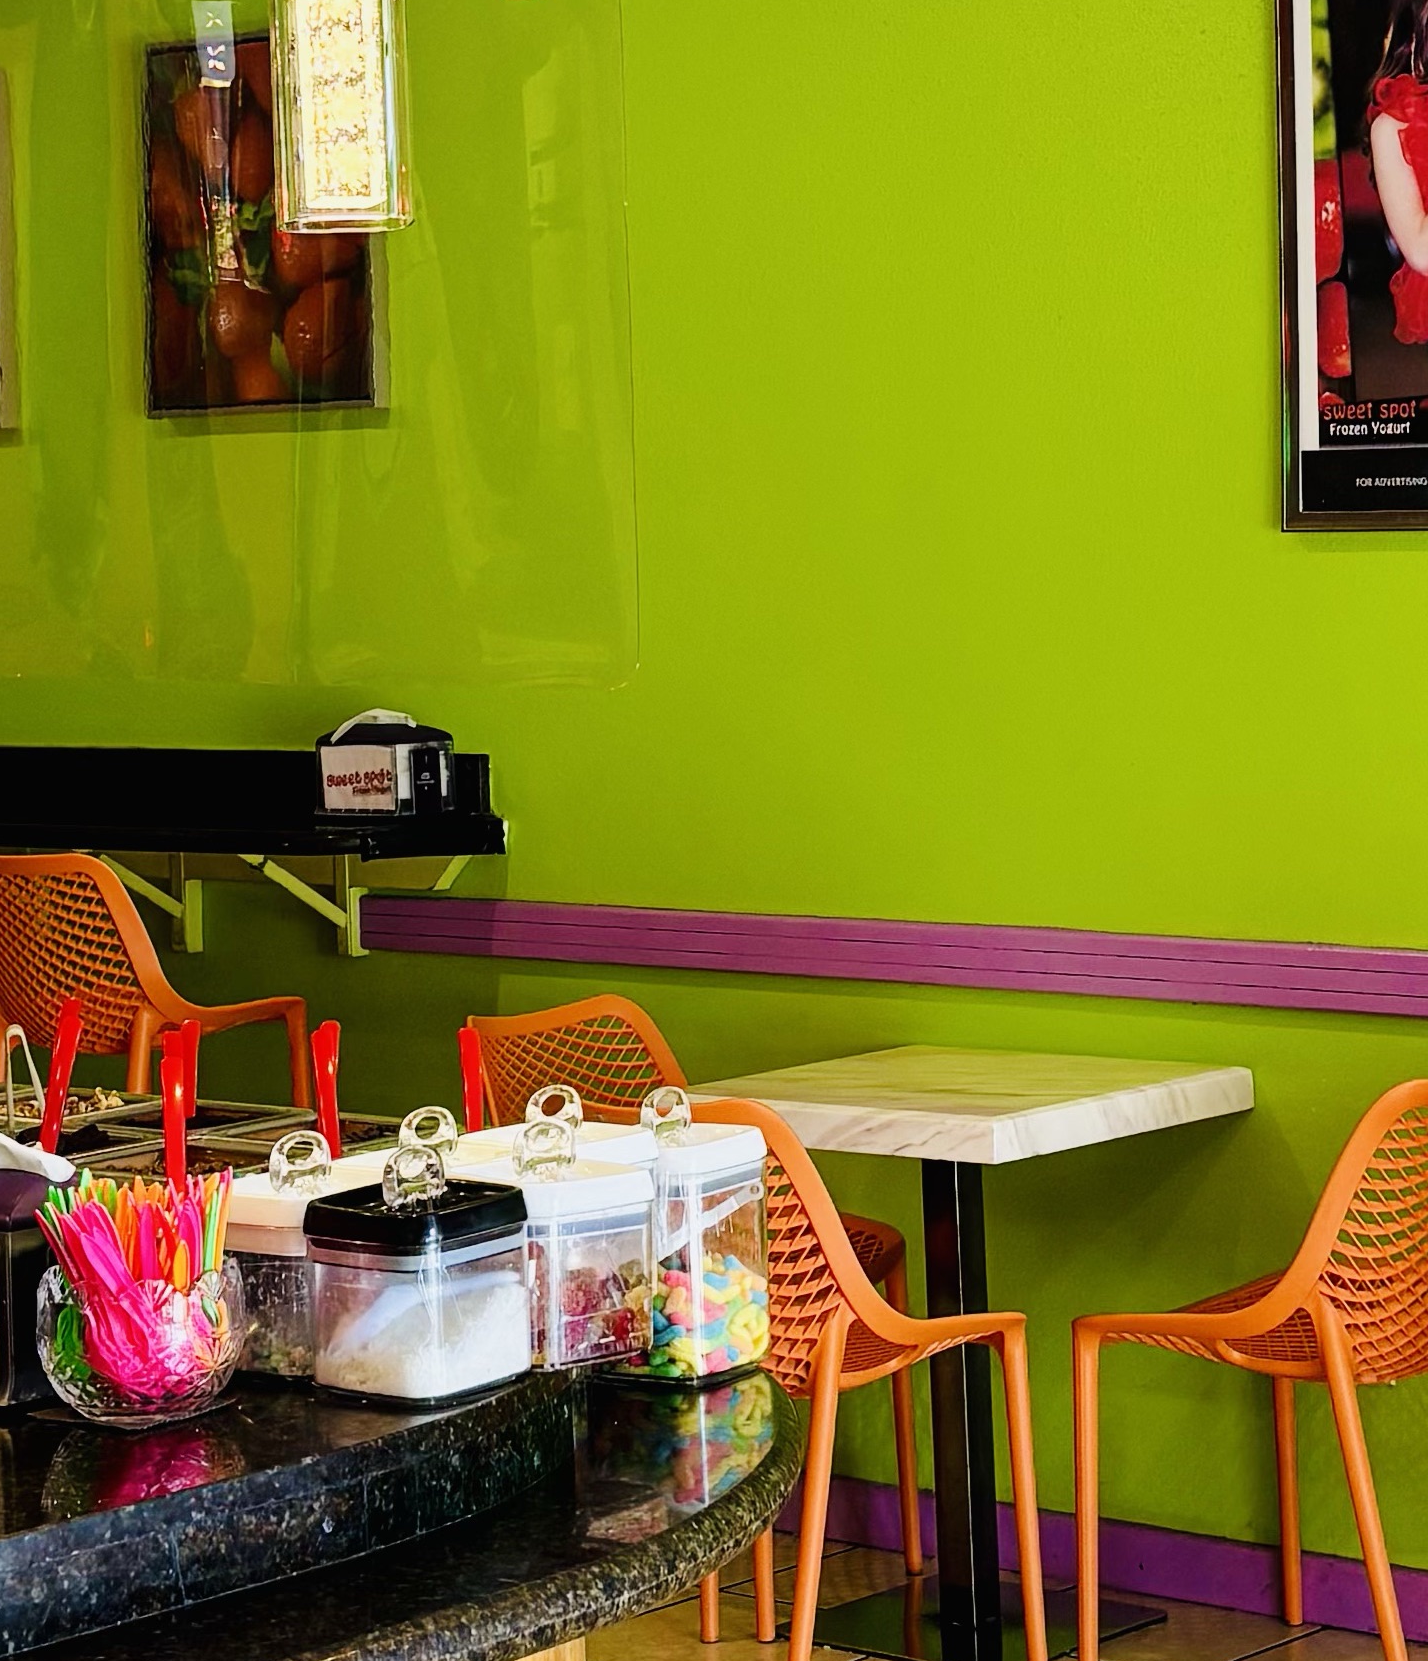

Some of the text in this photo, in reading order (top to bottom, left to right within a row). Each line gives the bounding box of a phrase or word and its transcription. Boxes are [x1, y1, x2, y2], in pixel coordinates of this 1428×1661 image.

[1323, 399, 1416, 420] sweet spot
[1329, 421, 1411, 437] Frozen Yogurt
[1356, 477, 1373, 487] FOR
[327, 770, 362, 788] sweet
